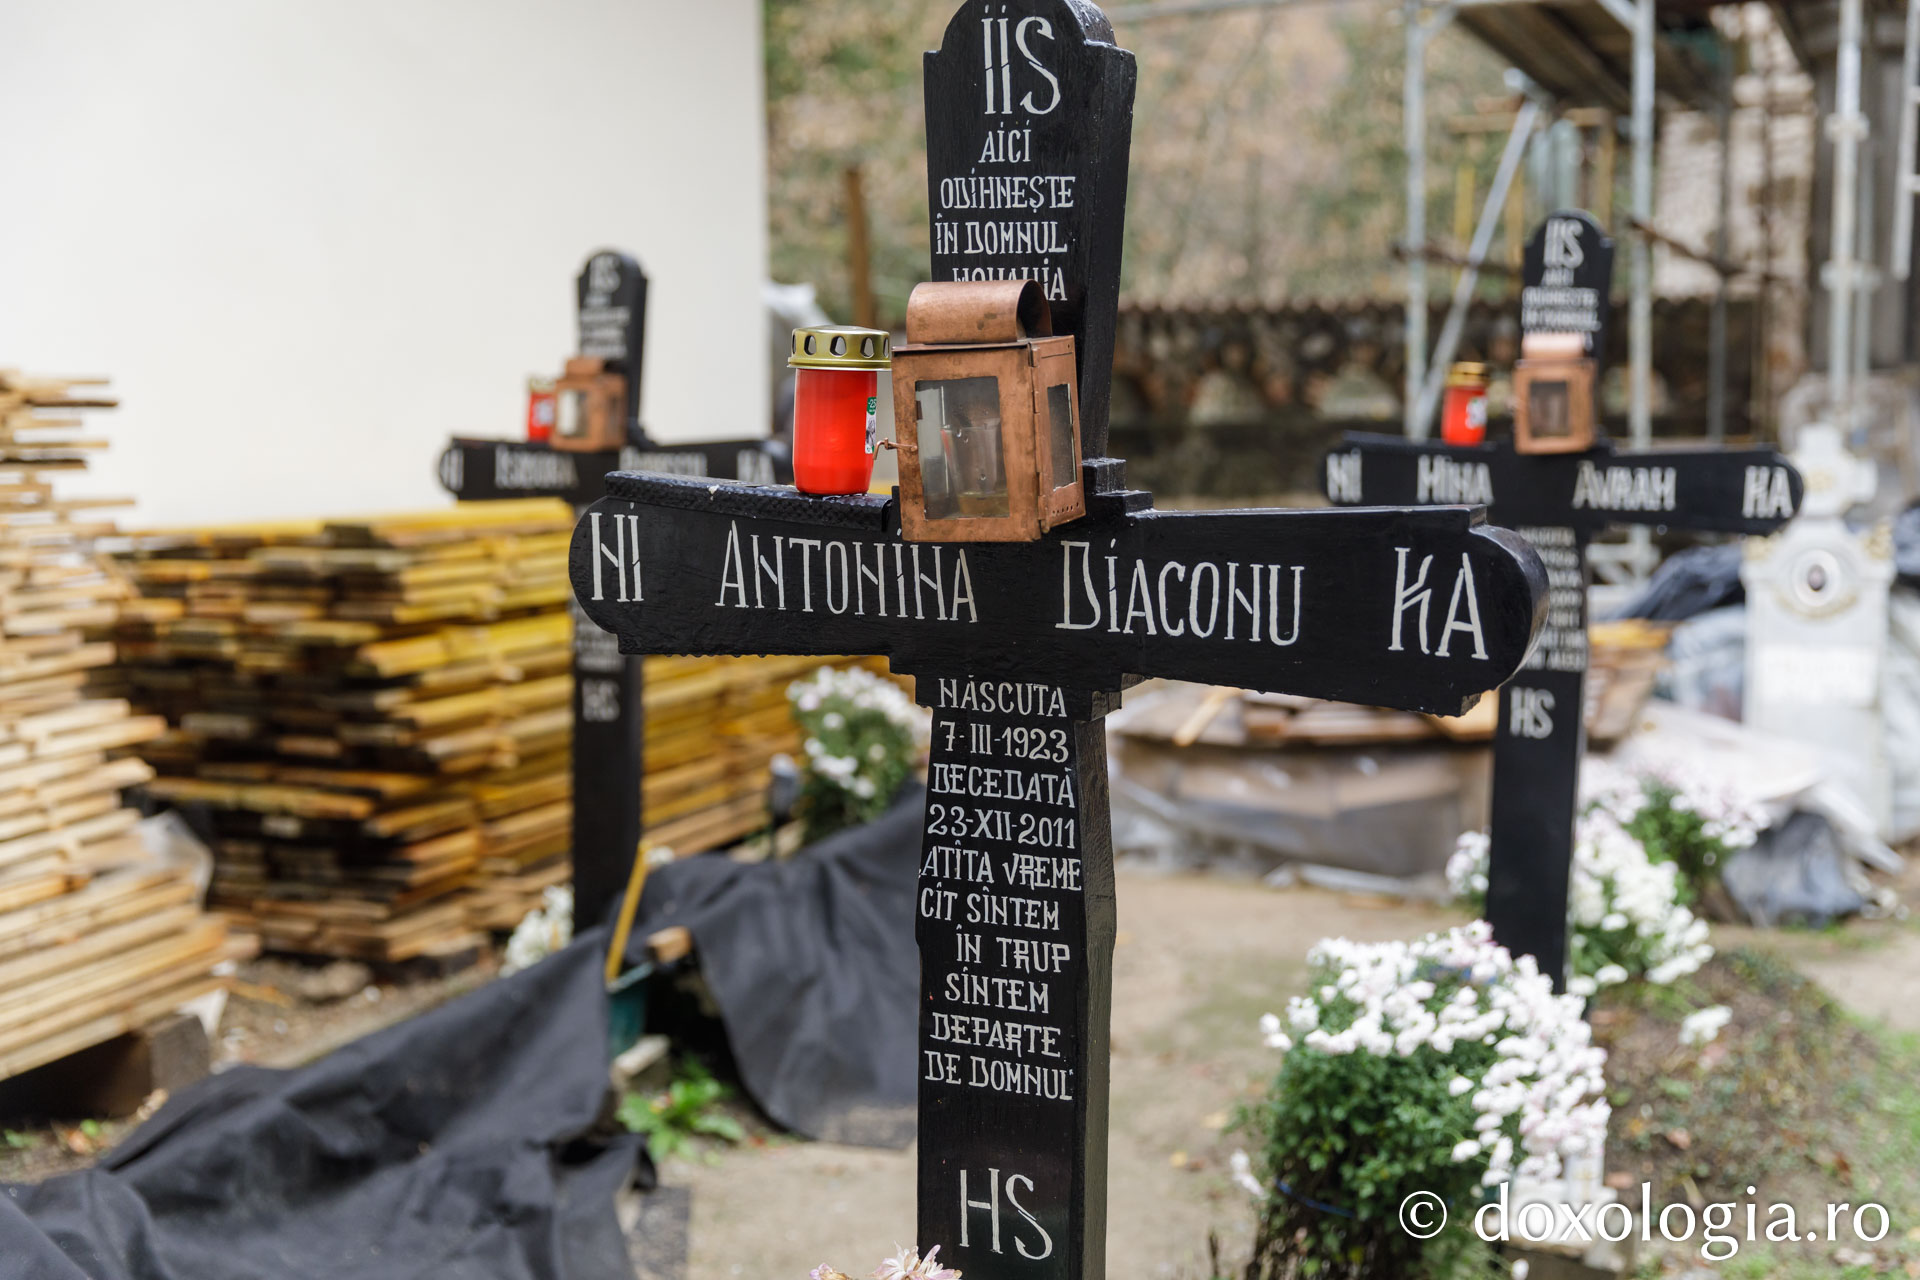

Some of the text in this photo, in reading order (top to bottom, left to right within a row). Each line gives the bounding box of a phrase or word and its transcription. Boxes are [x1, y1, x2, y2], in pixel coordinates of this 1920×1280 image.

[964, 221, 1067, 255] DOMNUL
[1388, 547, 1489, 660] KA
[931, 762, 1076, 808] DECEDATĂ
[927, 803, 1076, 849] 23-XII-2011
[1002, 852, 1082, 891] VREME
[996, 936, 1071, 974] TRUP
[929, 1011, 1061, 1058] DEPARTE
[924, 1050, 1073, 1100] DE DOMNUL
[959, 1167, 1053, 1261] HS
